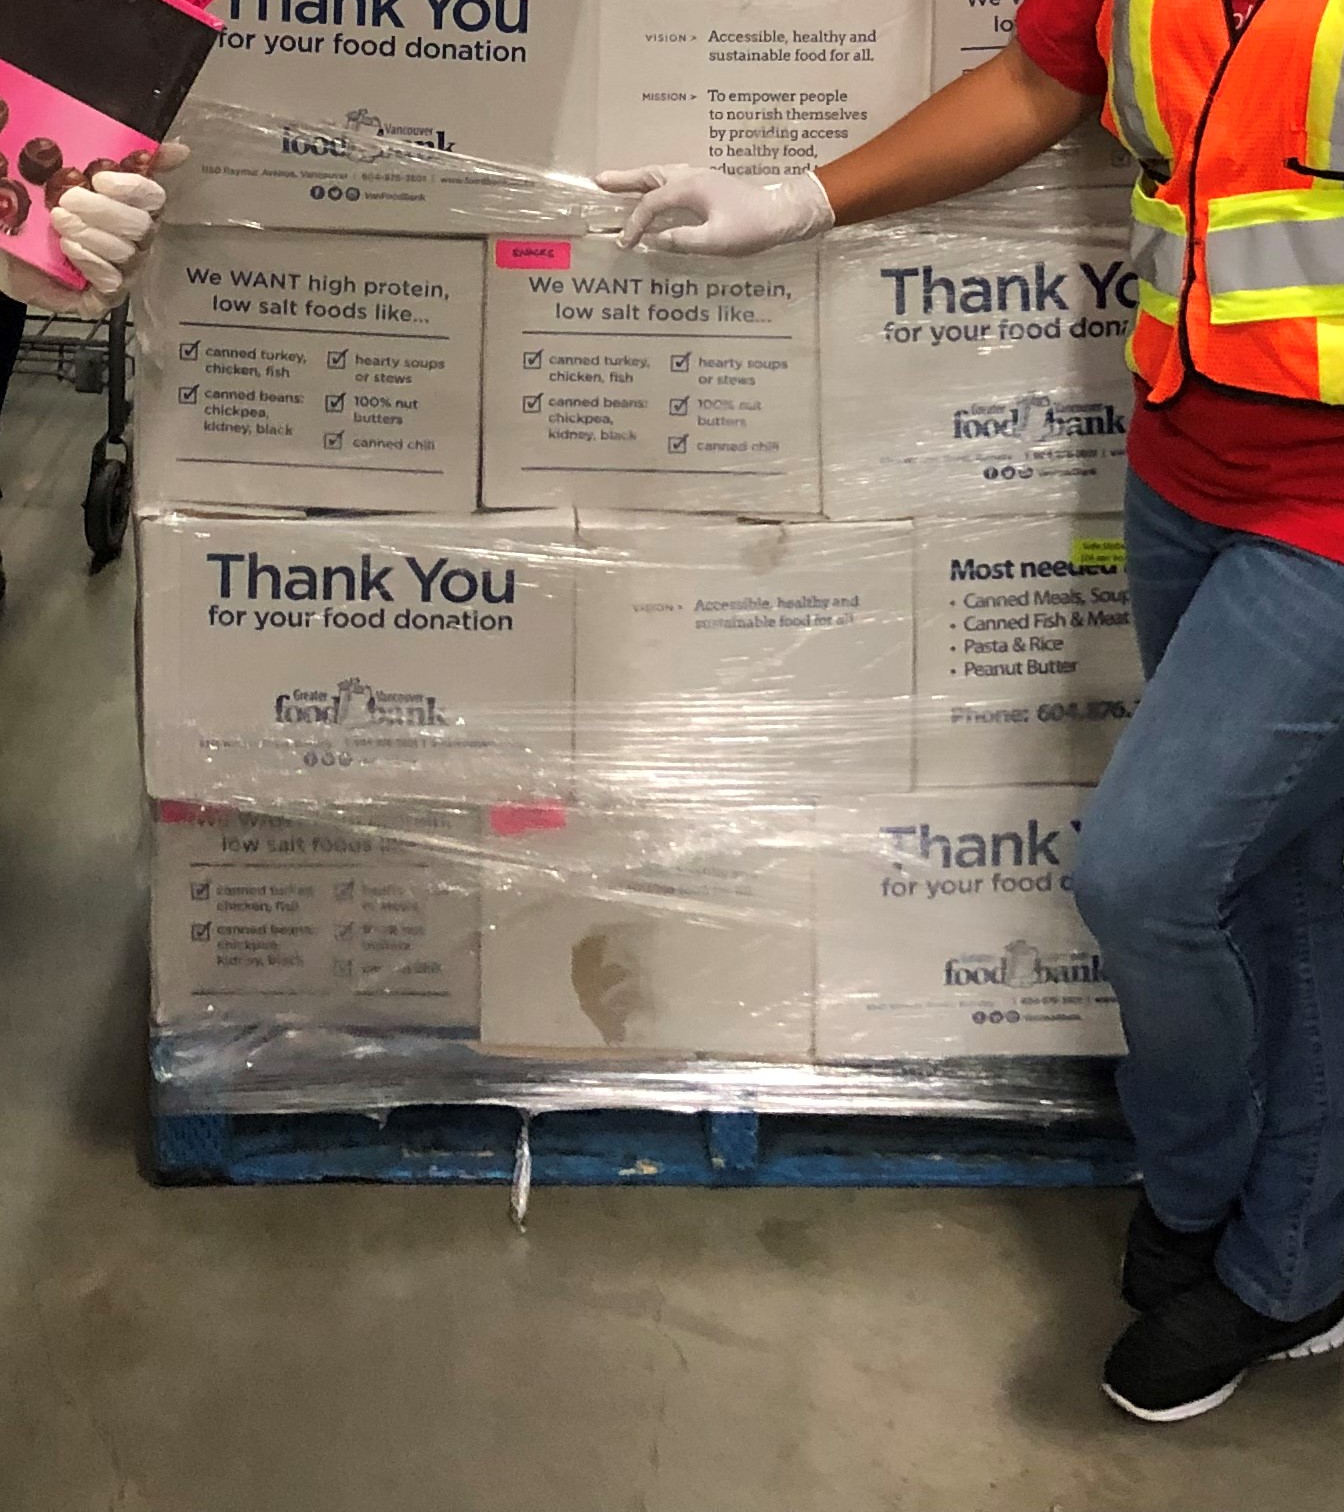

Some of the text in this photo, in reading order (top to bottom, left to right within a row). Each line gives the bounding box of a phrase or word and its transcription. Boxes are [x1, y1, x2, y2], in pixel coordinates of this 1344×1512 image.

[218, 29, 527, 63] for your food donation
[645, 30, 877, 47] VISION Accessible, healthy and
[709, 48, 875, 62] sustainable food for all.
[642, 89, 848, 106] MISSION To empower people
[709, 108, 868, 122] to nourish themselves
[385, 122, 434, 136] Vancouver
[709, 126, 849, 141] by providing access
[709, 145, 818, 160] to healthy food,
[784, 162, 811, 176] and
[186, 267, 449, 301] We WANT high protein,
[529, 277, 792, 300] We WANT high protein,
[880, 261, 1069, 316] Thank
[213, 295, 429, 324] low salt foods like...
[556, 303, 772, 324] low salt foods like...
[884, 321, 921, 344] for
[930, 322, 991, 346] your
[999, 318, 1061, 340] food
[205, 346, 306, 364] canned turkey,
[355, 354, 445, 371] hearty soups
[549, 354, 650, 369] canned turkey,
[699, 356, 788, 371] hearty soups
[205, 363, 290, 378] chicken, fish
[355, 372, 412, 385] or stews
[549, 370, 634, 384] chicken, fish
[699, 374, 756, 386] or stews
[204, 388, 256, 402] canned
[354, 396, 418, 410] 100% nut
[548, 396, 599, 409] canned
[204, 404, 268, 420] chickpea,
[354, 413, 403, 425] butters
[548, 412, 613, 426] chickpea,
[256, 422, 293, 436] black
[954, 405, 1126, 439] food bank
[352, 437, 402, 450] canned
[207, 553, 515, 604] Thank You
[950, 559, 1015, 581] Most
[833, 595, 859, 607] and
[964, 589, 1086, 609] Canned Meals,
[208, 606, 513, 631] for your food donation
[964, 615, 1029, 632] Canned
[1034, 612, 1066, 628] Fish
[1070, 615, 1084, 627] &
[964, 637, 1064, 654] Pasta & Rice
[964, 659, 1078, 676] Peanut Butter
[275, 694, 340, 724] food
[879, 819, 1060, 868] Thank
[882, 872, 1052, 899] for your food
[944, 958, 1007, 985] food
